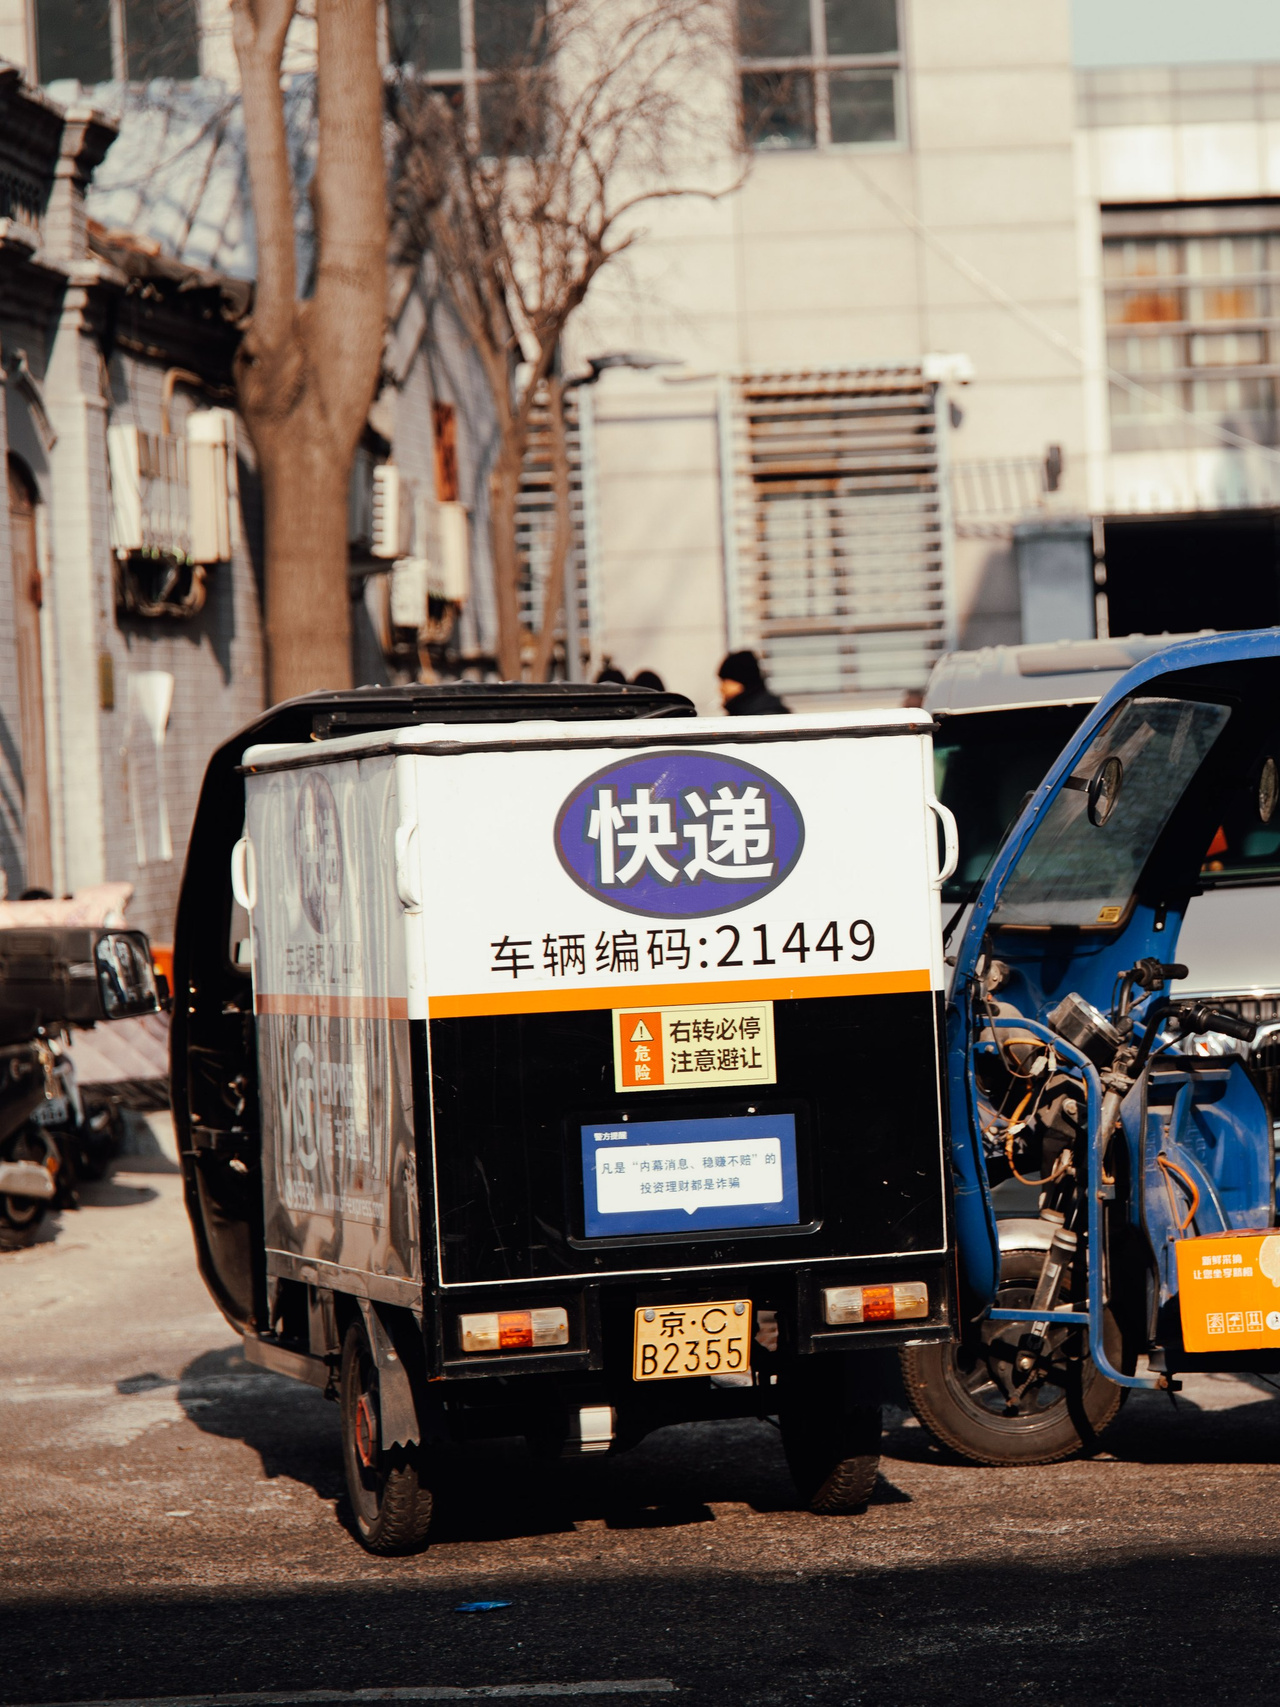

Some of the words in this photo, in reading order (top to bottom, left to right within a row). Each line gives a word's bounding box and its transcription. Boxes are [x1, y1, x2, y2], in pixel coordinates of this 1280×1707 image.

[587, 786, 775, 884] 快递
[490, 919, 876, 979] 车辆编码:21449
[669, 1016, 761, 1044] 右转必停
[634, 1045, 652, 1081] 危险
[670, 1046, 763, 1074] 注意避让
[640, 1177, 741, 1194] 投资理财都是诈骗
[641, 1337, 743, 1376] B2355
